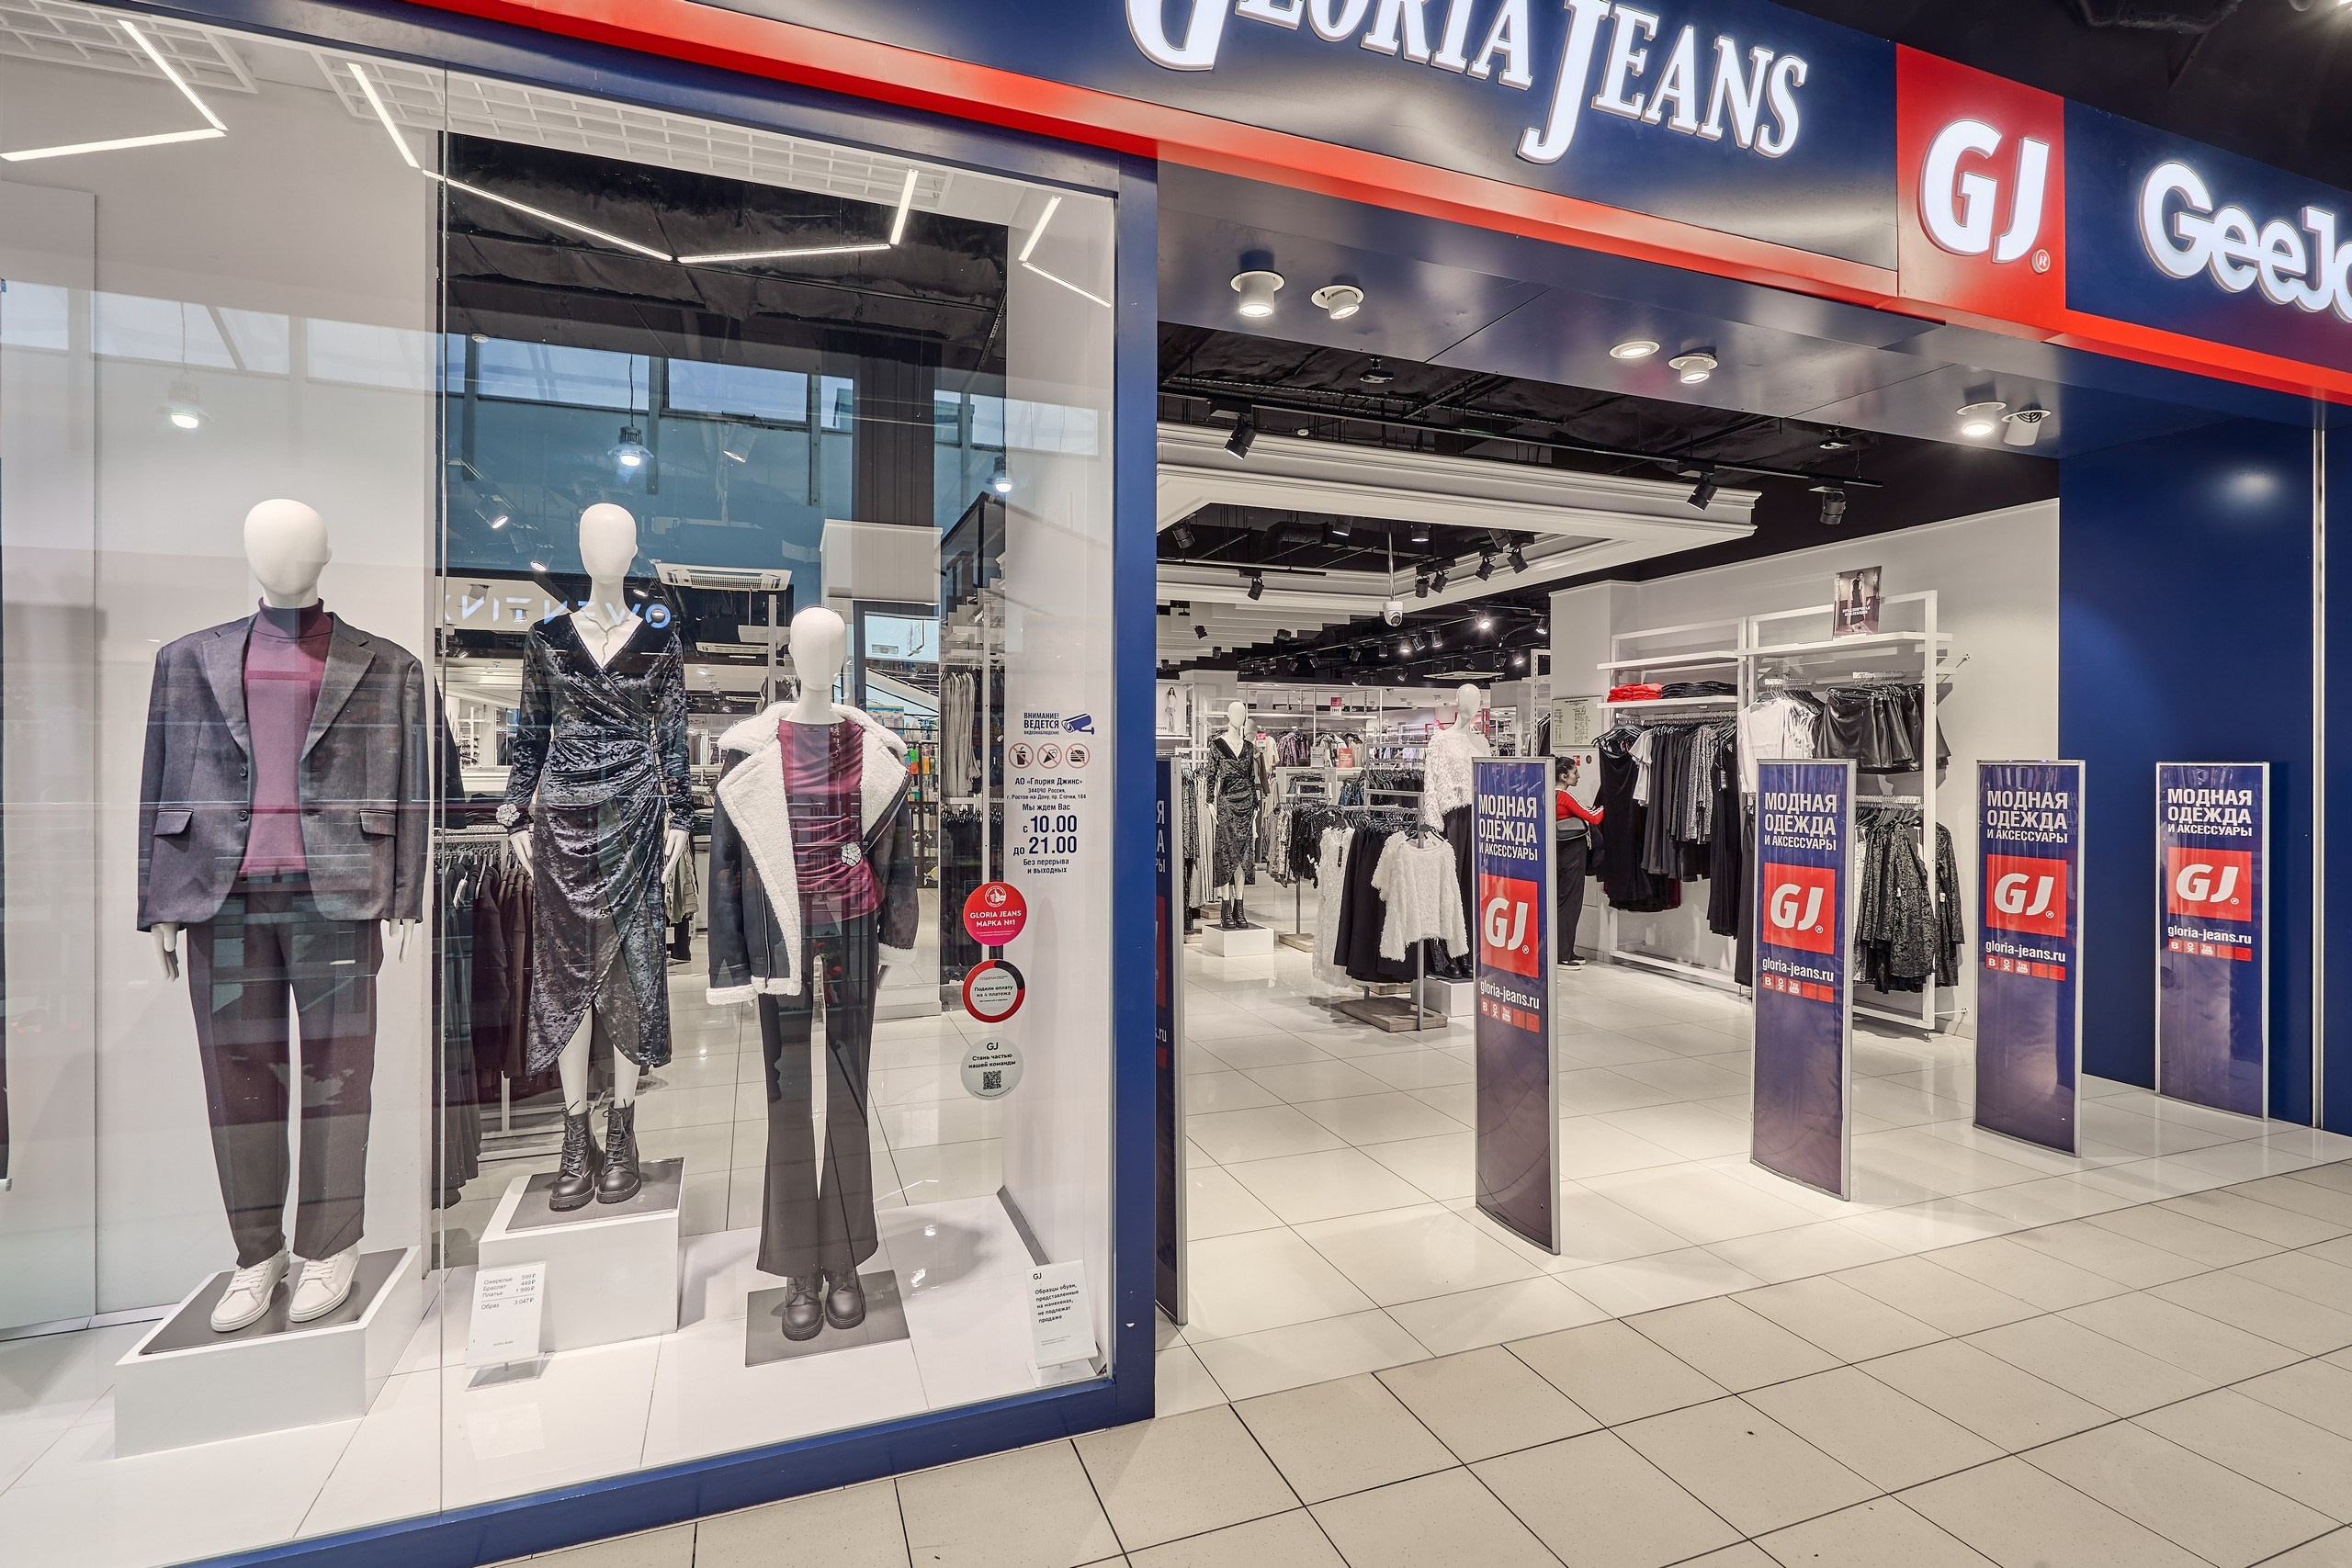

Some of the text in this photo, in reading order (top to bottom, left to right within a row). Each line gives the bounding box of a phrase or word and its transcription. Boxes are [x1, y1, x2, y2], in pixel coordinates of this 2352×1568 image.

[1517, 0, 1807, 164] JEANS
[1918, 118, 2051, 264] GJ
[1024, 720, 1059, 729] ВЕДЕТСЯ
[1479, 795, 1537, 819] МОДНАЯ
[1765, 793, 1838, 815] МОДНАЯ
[1987, 791, 2068, 810] МОДНАЯ
[2168, 789, 2252, 807] МОДНАЯ
[1031, 816, 1078, 833] 10.00
[1765, 814, 1837, 838] ОДЕЖДА
[1987, 810, 2068, 831] ОДЕЖДА
[2168, 807, 2252, 826] ОДЕЖДА
[1479, 818, 1537, 846] ОДЕЖДА
[1987, 829, 2068, 843] И АКСЕССУАРЫ
[2168, 824, 2252, 836] И АКСЕССУАРЫ
[1013, 836, 1078, 856] до 21.00
[1479, 842, 1538, 861] И АКСЕССУАРЫ
[1764, 835, 1837, 851] И АКСЕССУАРЫ
[2176, 863, 2239, 903] GJ
[1994, 873, 2054, 916] GJ
[1770, 884, 1825, 931] GJ
[1485, 897, 1529, 950] GJ
[2167, 925, 2252, 943] gloria-jeans.ru
[1985, 941, 2066, 962] gloria-jeans.ru
[1763, 957, 1834, 982] gloria-jeans.ru
[1480, 980, 1540, 1010] gloria-jeans.ru
[986, 1042, 999, 1050] GJ
[1036, 1290, 1079, 1302] представленные
[1046, 1306, 1070, 1314] подлежат
